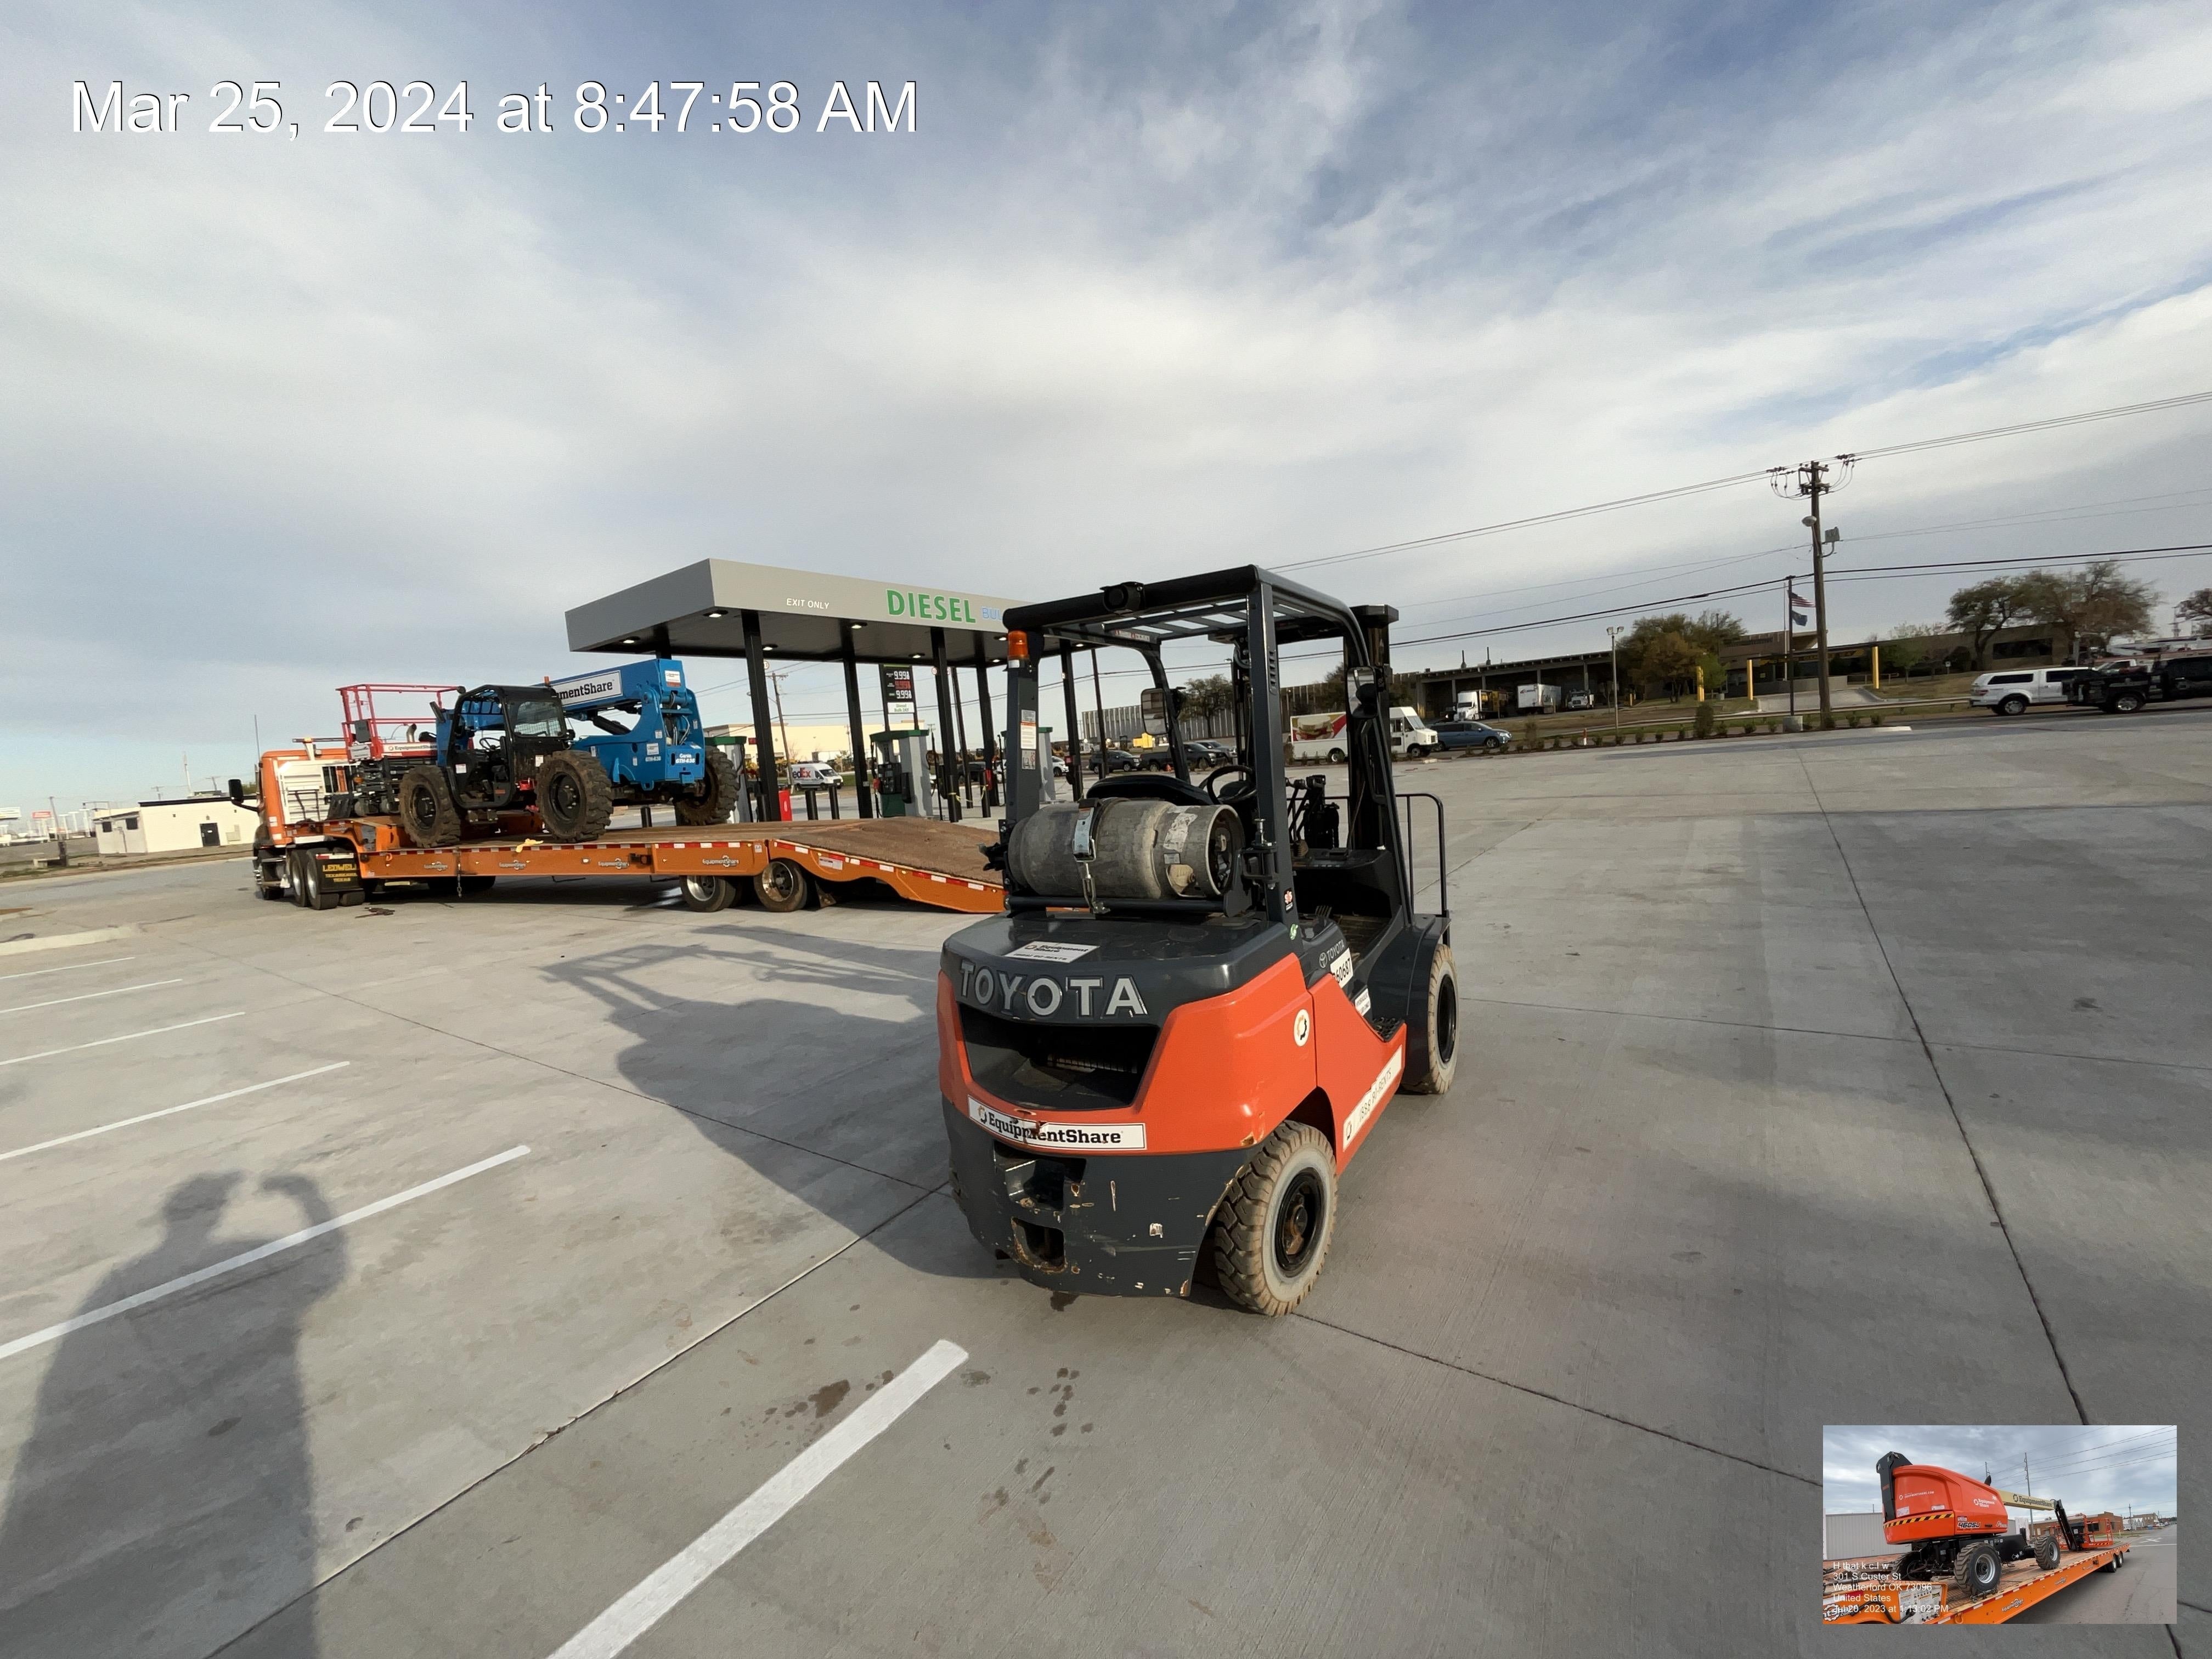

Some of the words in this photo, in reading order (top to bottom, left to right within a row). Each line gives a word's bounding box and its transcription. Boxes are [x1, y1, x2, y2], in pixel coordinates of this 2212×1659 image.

[786, 598, 805, 608] EXIT
[807, 600, 830, 610] ONLY
[886, 589, 977, 623] DIESEL
[981, 606, 1003, 621] BUL
[556, 681, 613, 700] mentShare
[792, 768, 811, 778] edEx
[1327, 939, 1345, 962] TOYOTA
[961, 962, 1148, 1017] TOYOTA
[988, 1111, 1121, 1143] EquipmentShare
[2019, 1496, 2052, 1508] EquipmentShare
